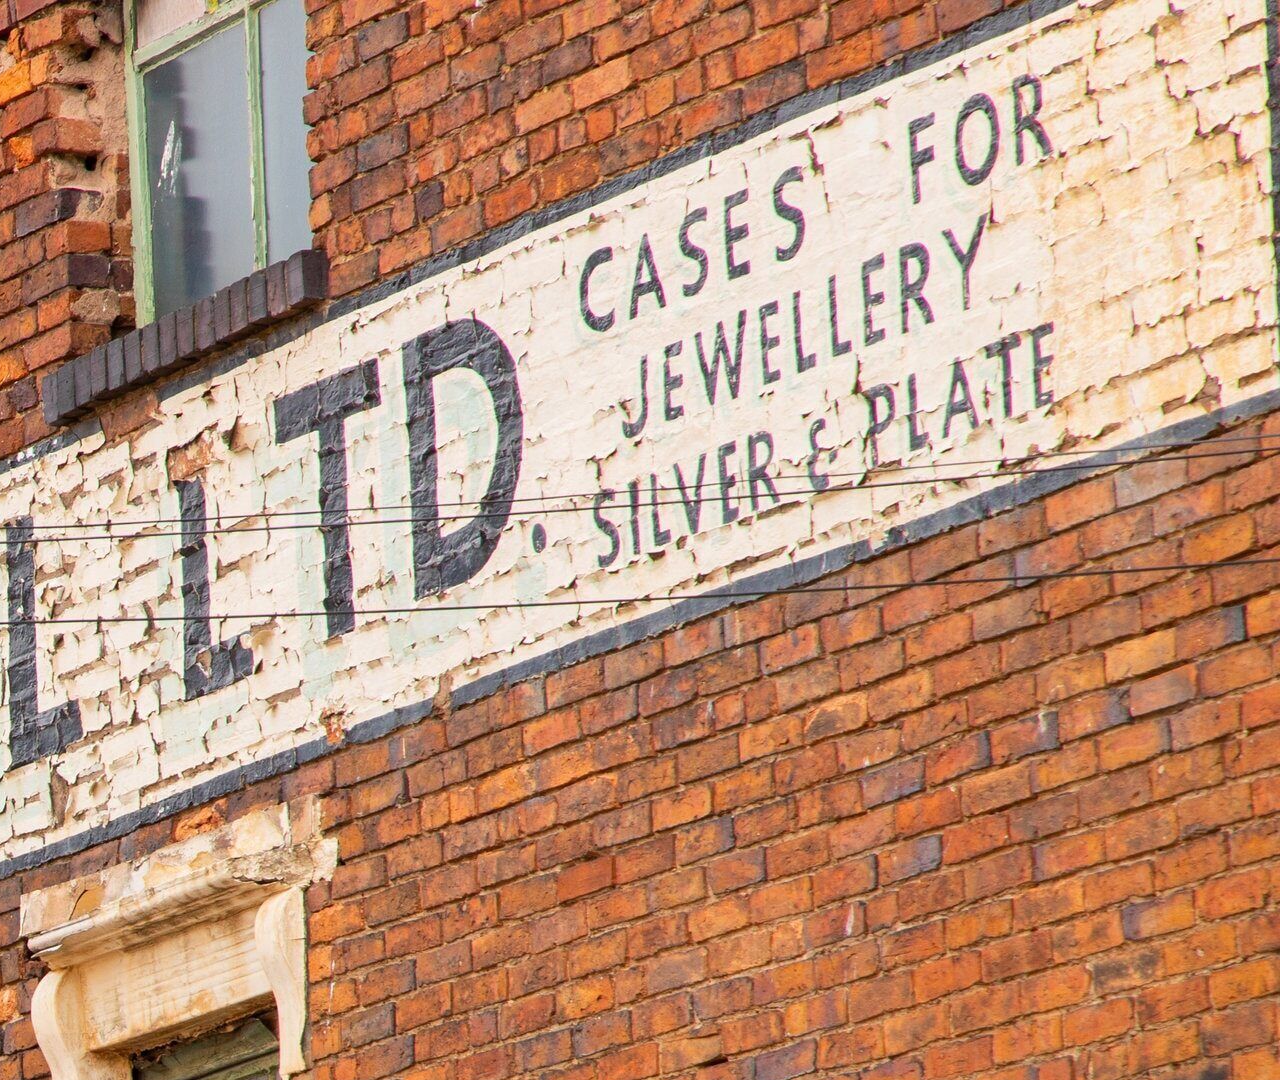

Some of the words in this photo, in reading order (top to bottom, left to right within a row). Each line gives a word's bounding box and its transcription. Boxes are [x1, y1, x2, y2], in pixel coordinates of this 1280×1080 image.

[578, 165, 807, 333] CASES
[907, 73, 1055, 205] FOR
[621, 212, 992, 439] JEWELLERY
[172, 317, 548, 702] LTD.
[592, 430, 781, 568] SILVER
[807, 418, 839, 492] &
[863, 321, 1055, 469] PLATE
